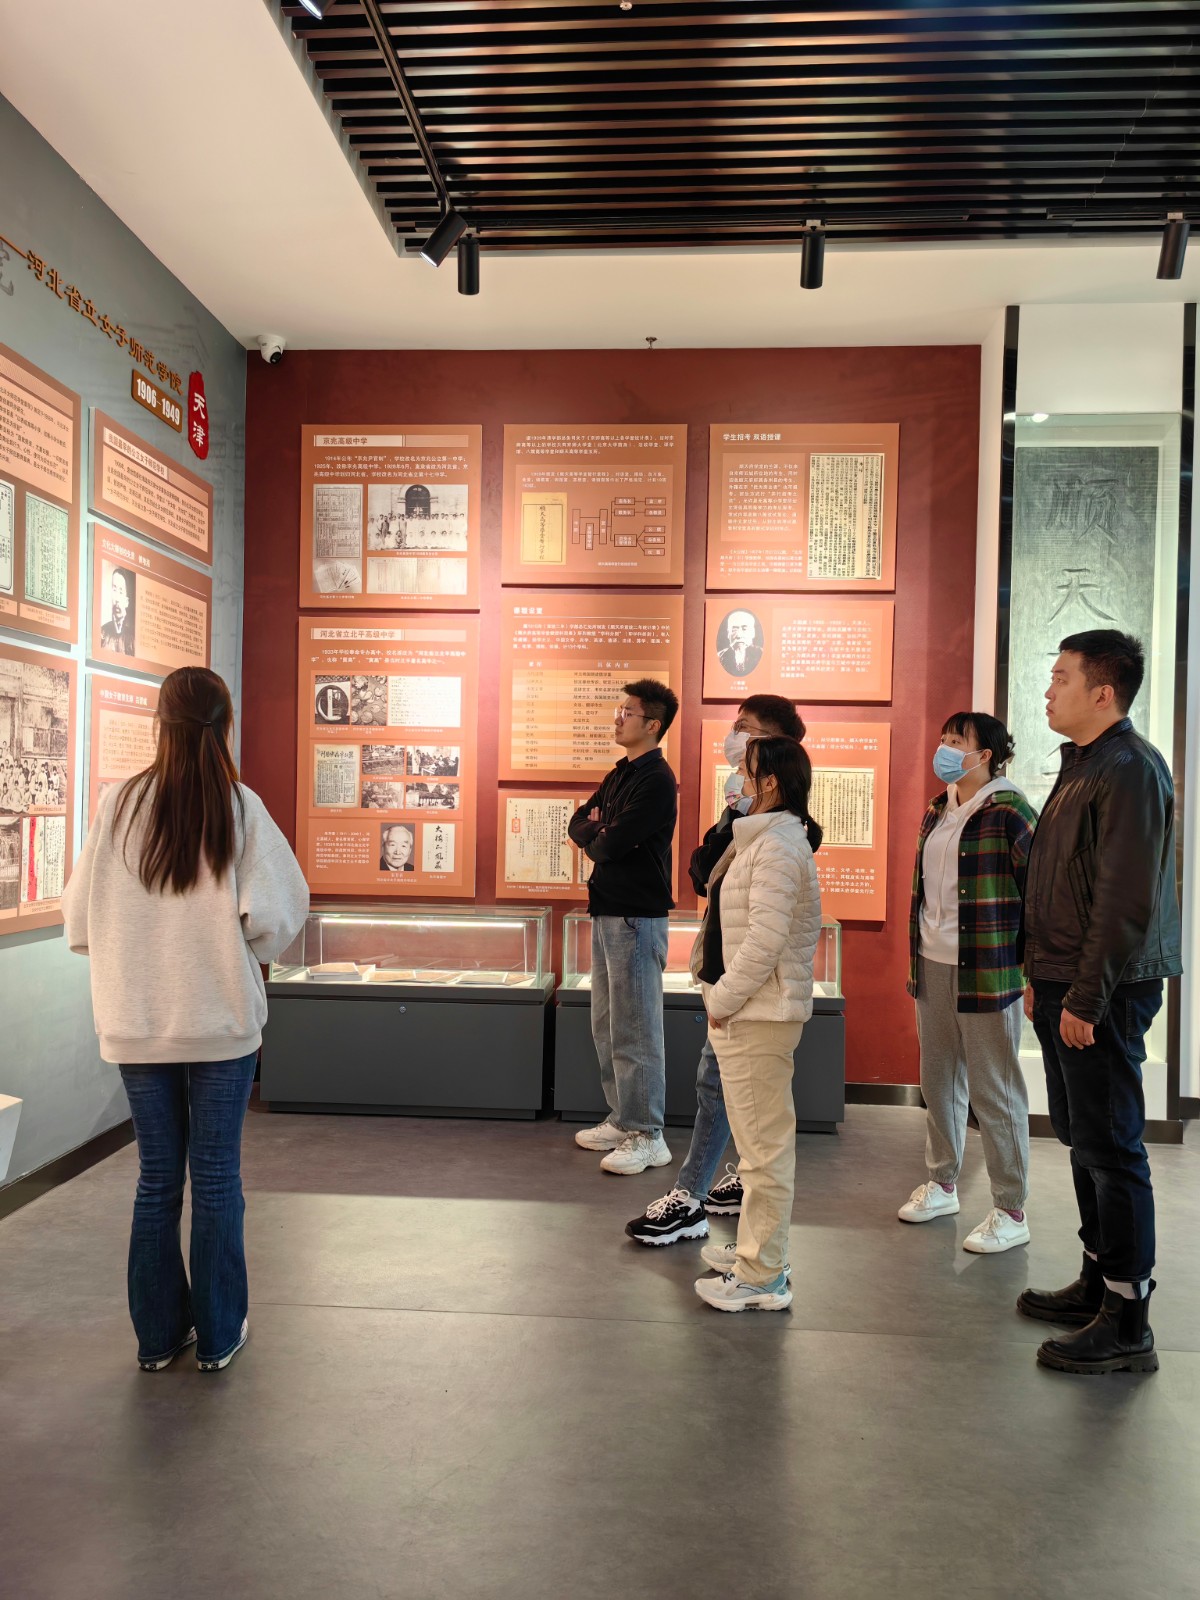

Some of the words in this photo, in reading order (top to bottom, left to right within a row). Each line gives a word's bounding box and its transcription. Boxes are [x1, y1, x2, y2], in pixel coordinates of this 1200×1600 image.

[192, 392, 207, 447] 天津
[723, 433, 751, 441] 学生招考
[753, 433, 782, 441] 双语授课
[320, 630, 396, 638] 河北省立北平高级中学
